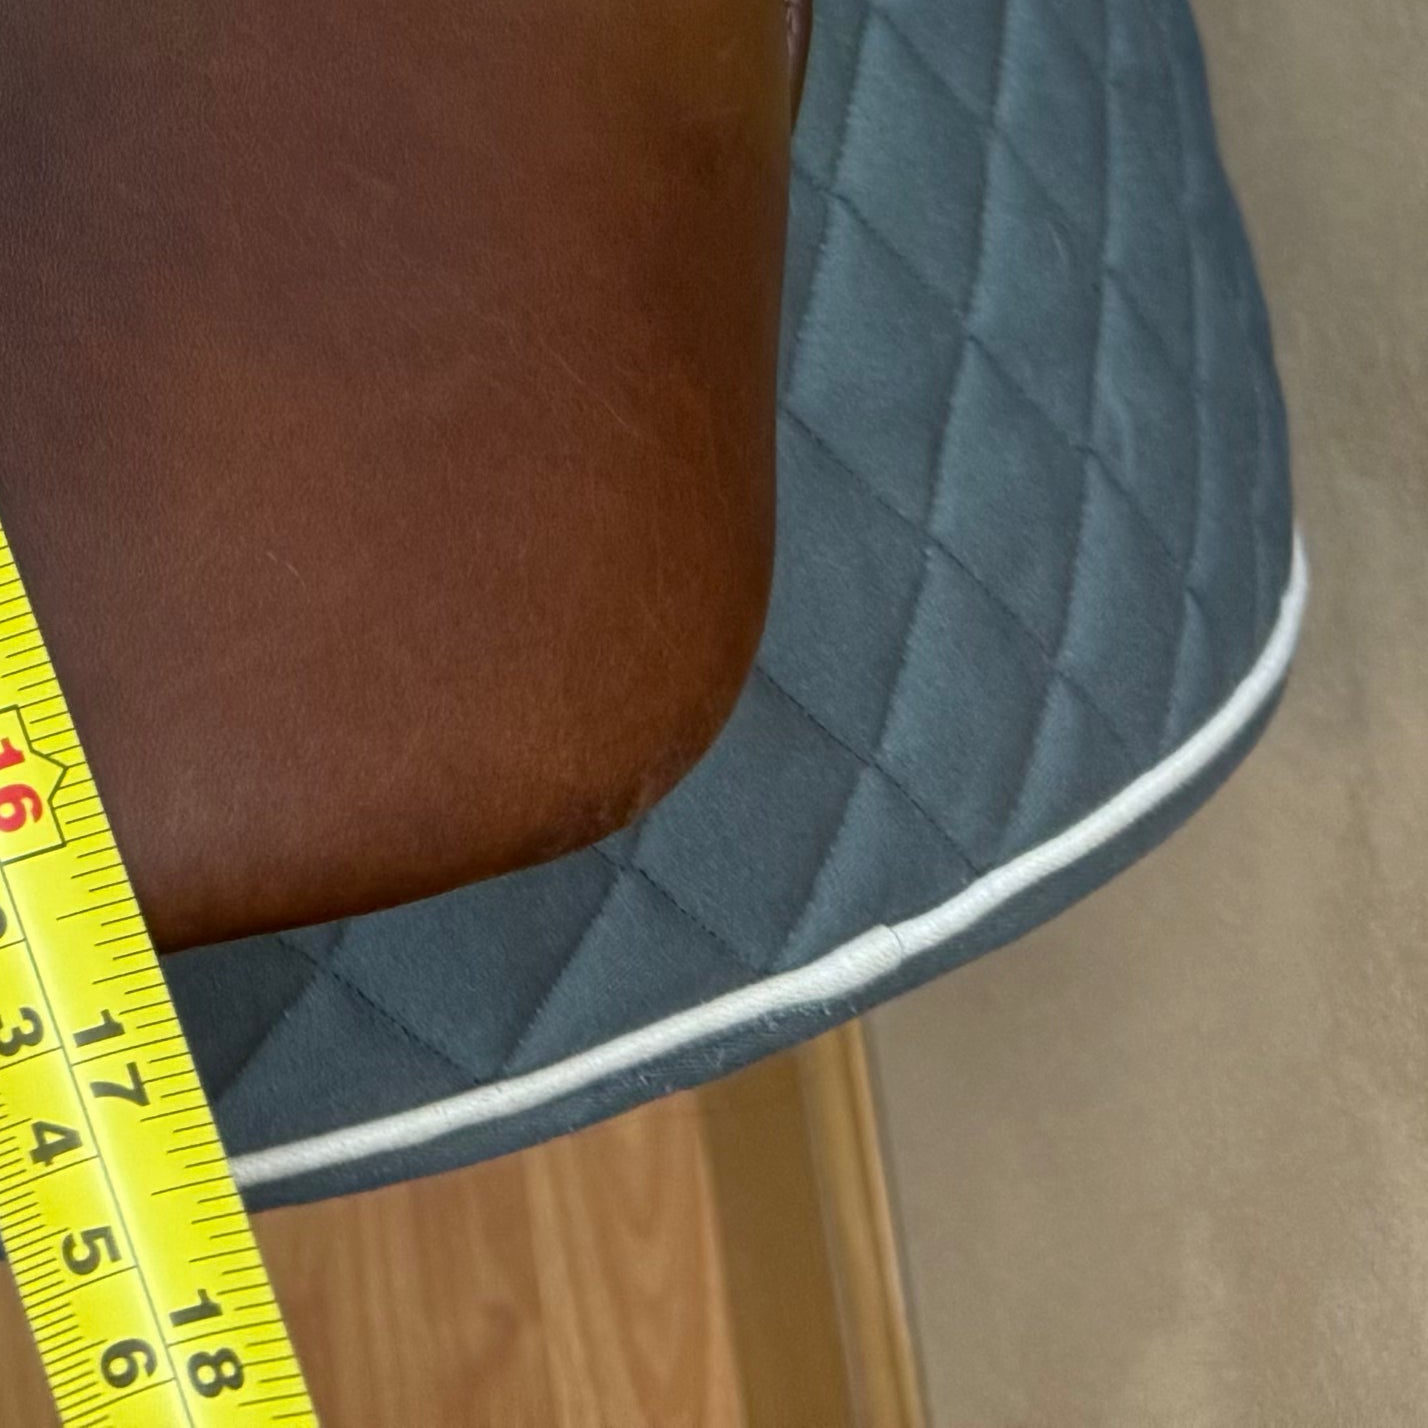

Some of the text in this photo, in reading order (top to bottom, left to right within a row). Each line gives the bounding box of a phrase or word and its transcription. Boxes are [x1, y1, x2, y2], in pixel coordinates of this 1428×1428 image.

[29, 1120, 83, 1167] 4
[62, 1225, 123, 1276] 5
[100, 1338, 158, 1389] 6
[73, 1009, 150, 1107] 17
[170, 1288, 245, 1398] 18
